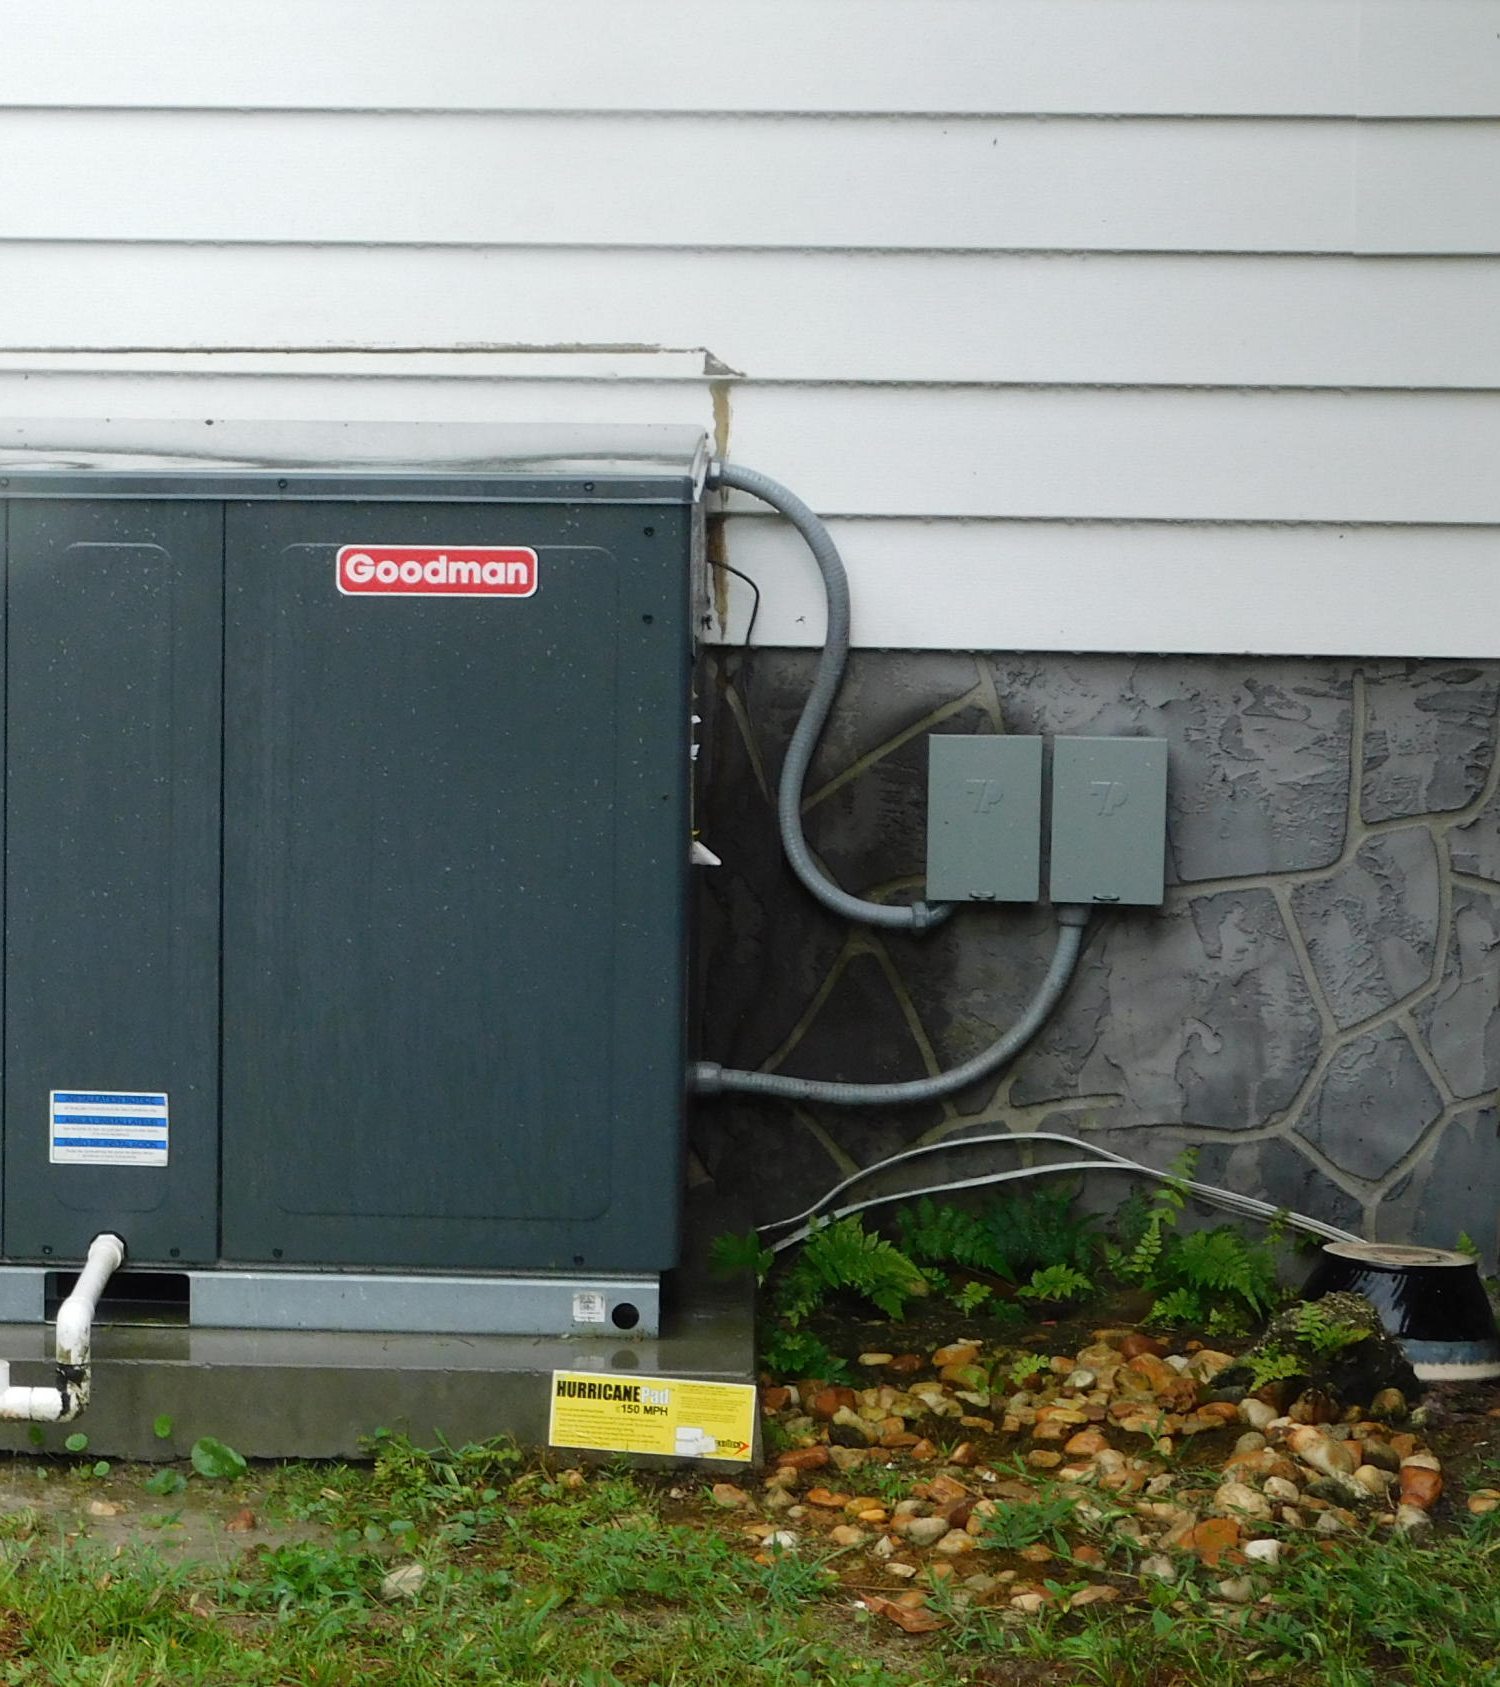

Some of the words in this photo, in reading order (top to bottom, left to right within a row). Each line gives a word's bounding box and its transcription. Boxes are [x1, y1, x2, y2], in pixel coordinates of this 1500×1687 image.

[345, 553, 528, 585] Goodman
[621, 1403, 640, 1415] 150
[643, 1405, 669, 1417] MPH
